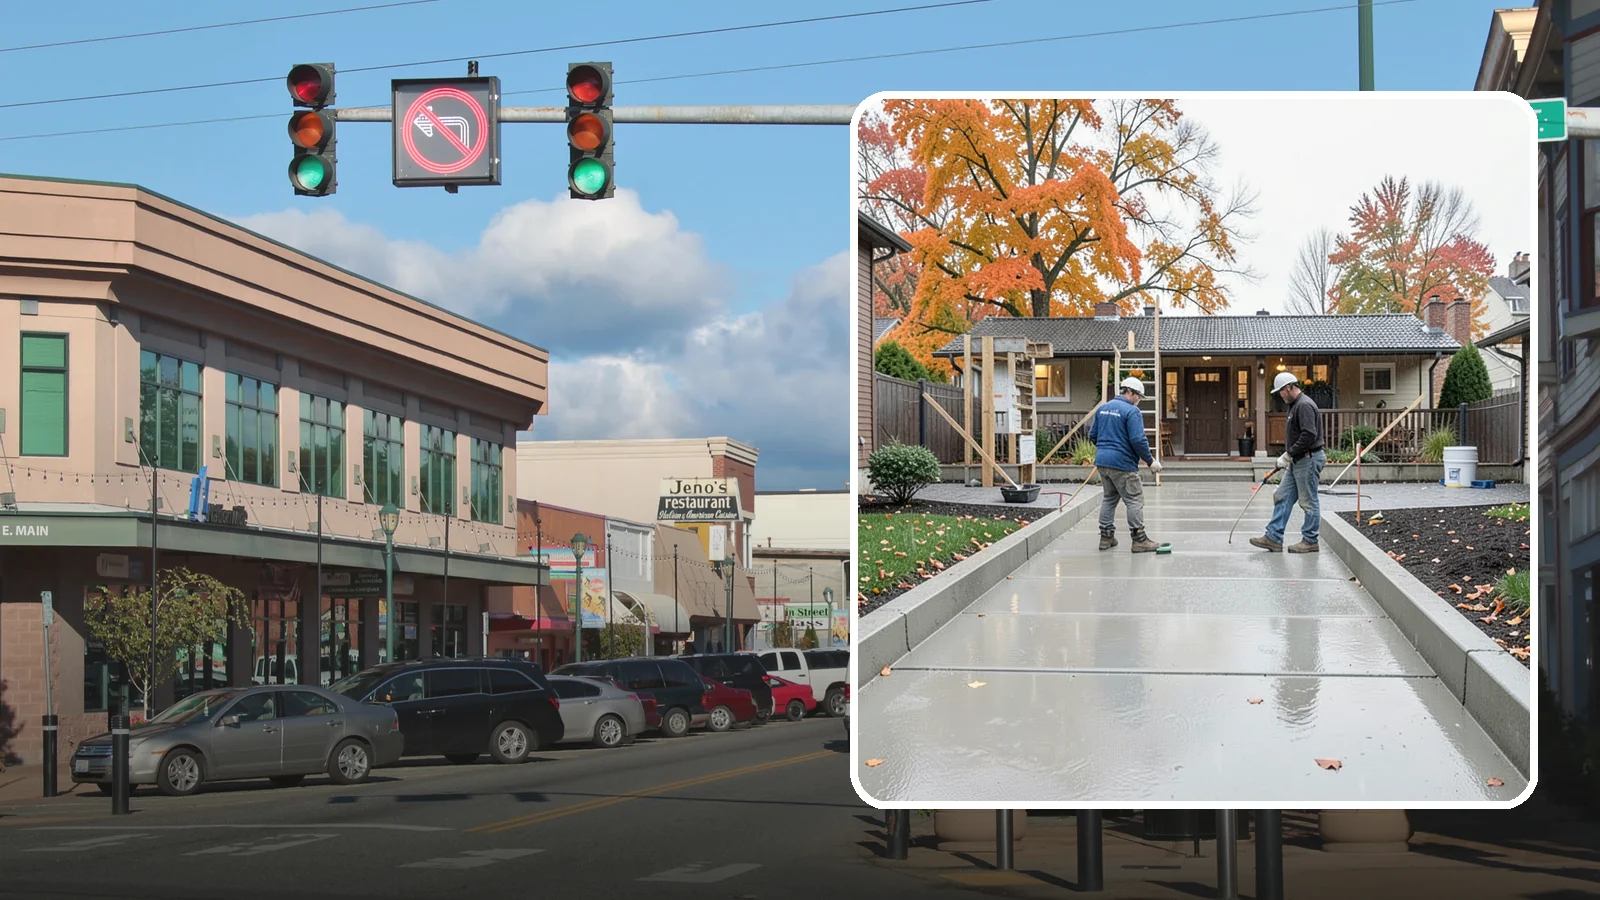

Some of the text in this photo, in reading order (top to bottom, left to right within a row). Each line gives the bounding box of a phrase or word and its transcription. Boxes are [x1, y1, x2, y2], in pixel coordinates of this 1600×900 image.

[670, 480, 727, 494] Jeno's
[665, 497, 731, 509] restaurant
[659, 510, 681, 519] Italian
[686, 510, 714, 519] American
[715, 510, 737, 519] Cuisine
[2, 525, 49, 536] E. MAIN
[798, 607, 828, 617] Street
[791, 619, 824, 627] lass
